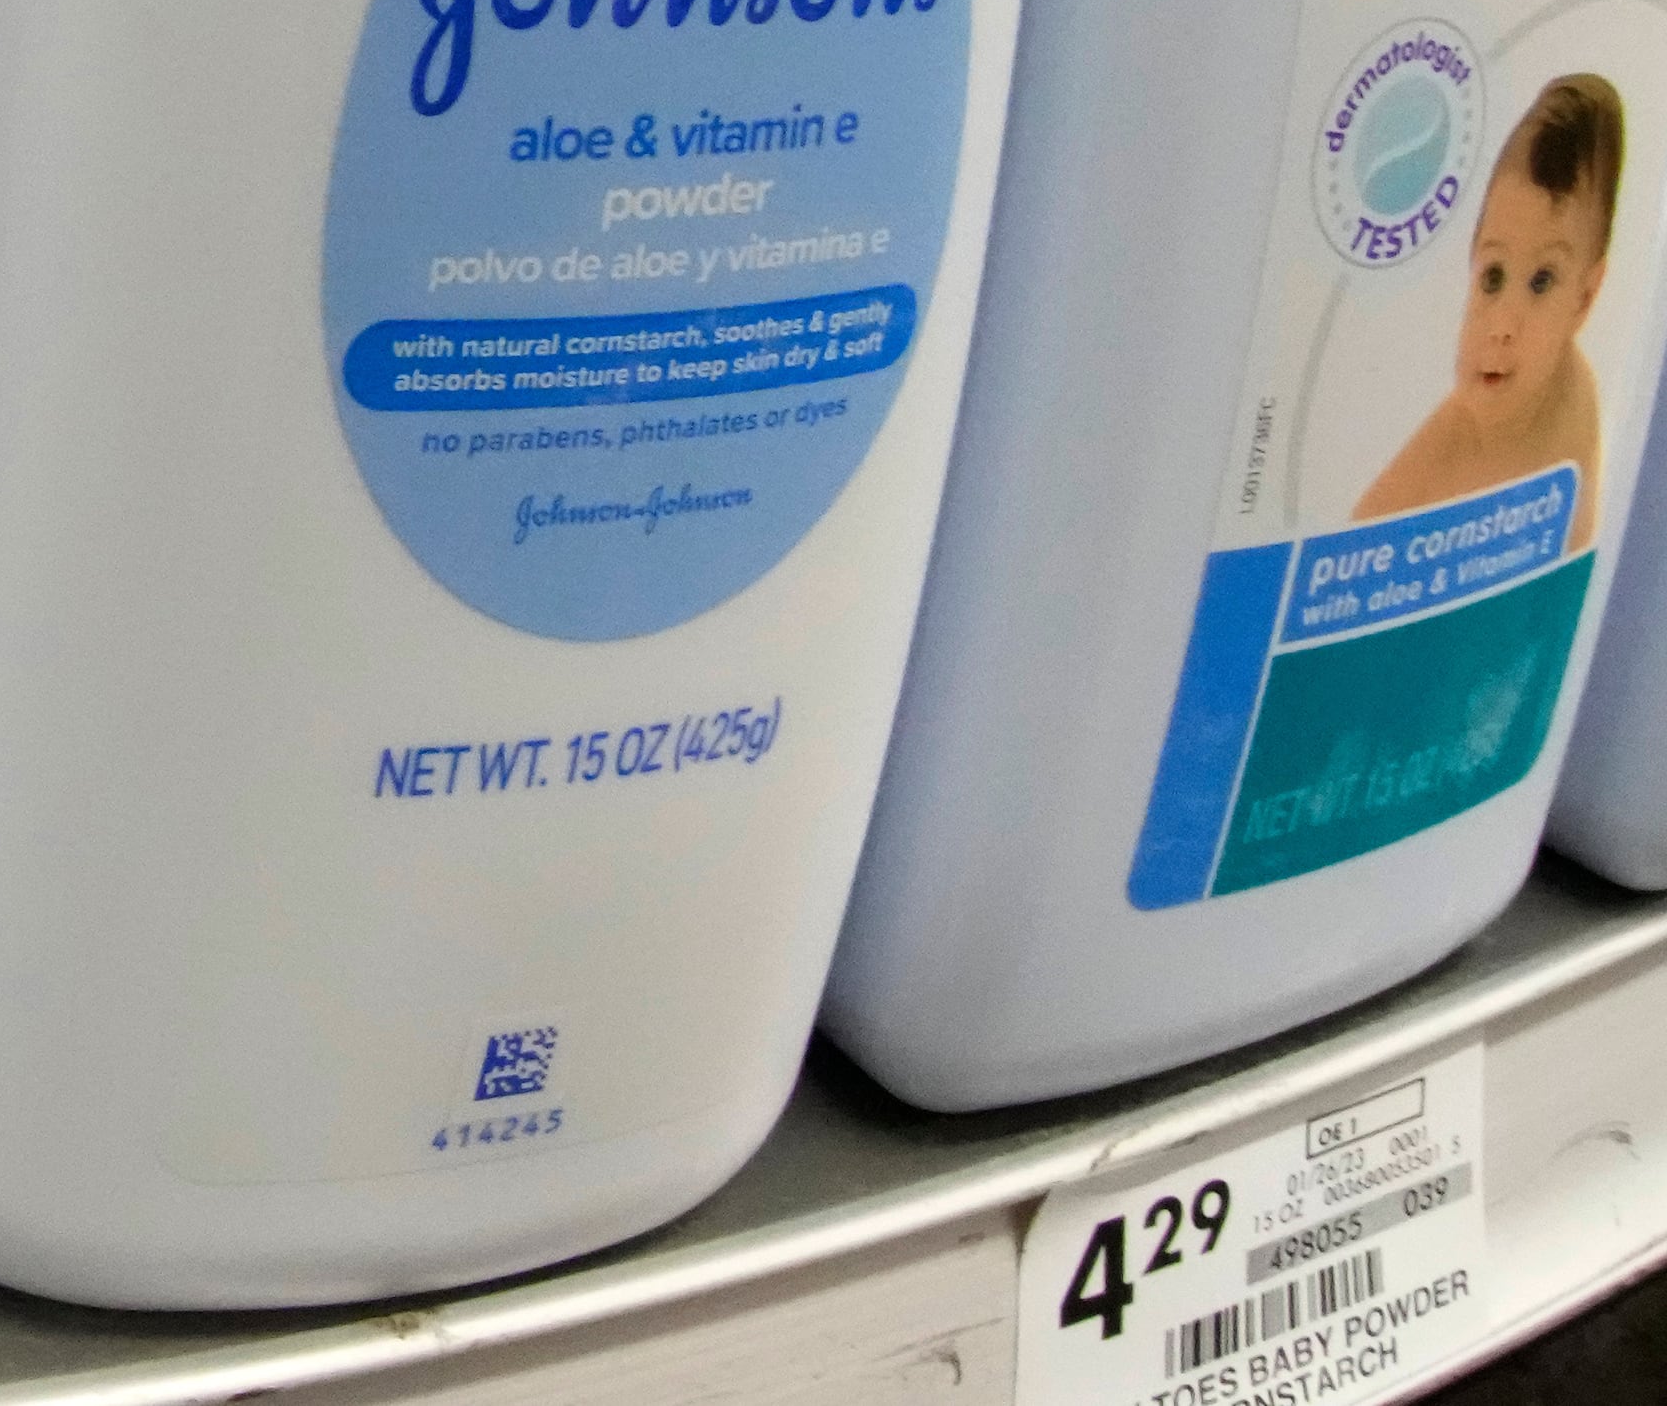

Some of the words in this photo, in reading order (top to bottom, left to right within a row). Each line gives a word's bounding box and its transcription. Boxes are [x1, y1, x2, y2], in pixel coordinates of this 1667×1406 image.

[1325, 30, 1470, 152] dermatologist
[509, 117, 613, 161] aloe
[624, 114, 657, 156] &
[671, 104, 824, 157] vitamin
[835, 110, 858, 143] e
[602, 172, 773, 231] powder
[1350, 176, 1458, 259] TESTED
[428, 249, 541, 290] polvo
[552, 249, 601, 282] de
[611, 242, 688, 281] aloe
[727, 230, 862, 270] vitamina
[871, 227, 890, 252] e
[393, 336, 454, 358] with
[462, 333, 560, 359] natural
[713, 316, 802, 346] soothes
[829, 301, 892, 334] gently
[394, 368, 506, 393] absorbs
[513, 364, 628, 390] moisture
[668, 357, 726, 385] keep
[734, 348, 779, 373] skin
[784, 344, 818, 373] dry
[843, 332, 882, 358] soft
[619, 413, 757, 449] phthalates
[795, 396, 847, 426] dyes
[1309, 544, 1395, 596] pure
[1406, 483, 1562, 564] cornstarch
[1303, 590, 1360, 626] with
[1368, 581, 1423, 611] aloe
[1429, 568, 1448, 595] &
[1458, 543, 1536, 585] Vitamin
[1541, 529, 1555, 554] E
[375, 746, 471, 796] NET
[479, 738, 549, 792] WT.
[568, 732, 609, 782] 15
[616, 723, 670, 777] OZ
[675, 696, 782, 772] (425g)
[432, 1109, 563, 1151] 414245
[1254, 1211, 1273, 1233] 15
[1271, 1211, 1363, 1269] 498055
[1403, 1176, 1448, 1217] 039
[1249, 1326, 1334, 1387] BABY
[1345, 1269, 1469, 1348] POWDER
[1232, 1337, 1398, 1406] NSTARCH
